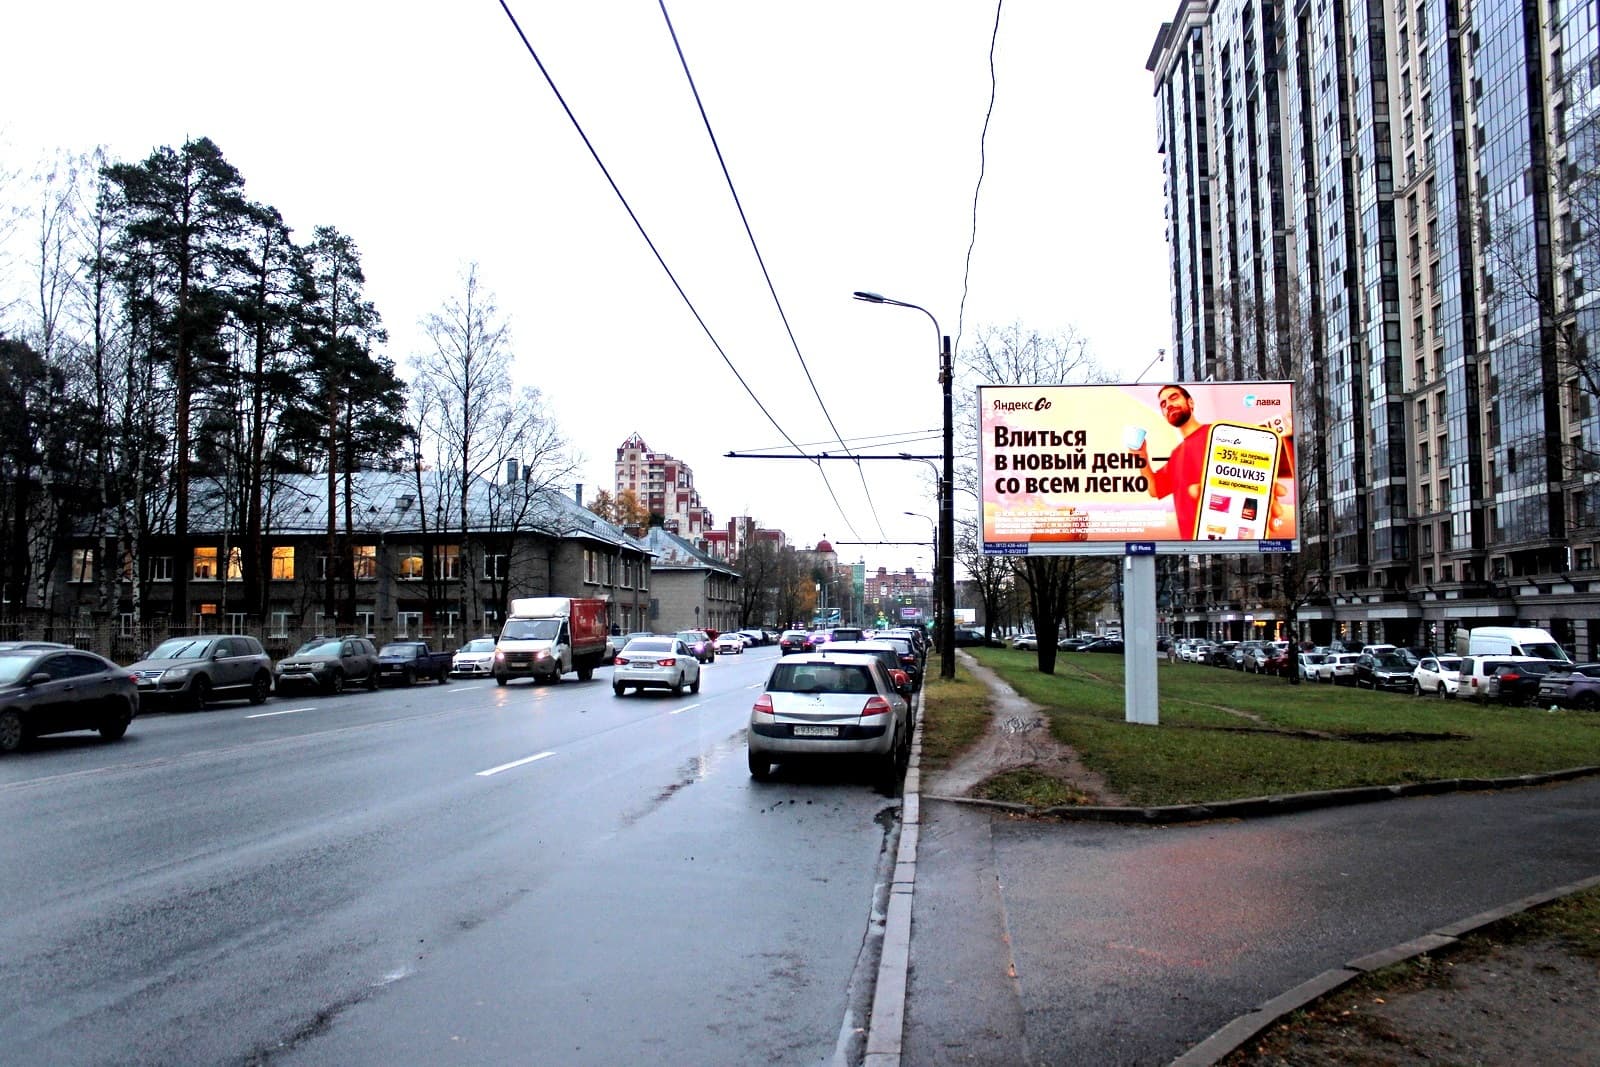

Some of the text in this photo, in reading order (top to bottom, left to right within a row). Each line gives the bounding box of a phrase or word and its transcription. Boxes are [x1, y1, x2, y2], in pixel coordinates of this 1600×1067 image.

[994, 397, 1052, 411] Яндекс Go
[1256, 398, 1281, 407] лавка
[994, 426, 1087, 448] Влиться
[995, 454, 1008, 471] в
[1013, 449, 1087, 471] новый
[1092, 453, 1147, 473] день
[995, 475, 1149, 495] со всем легко
